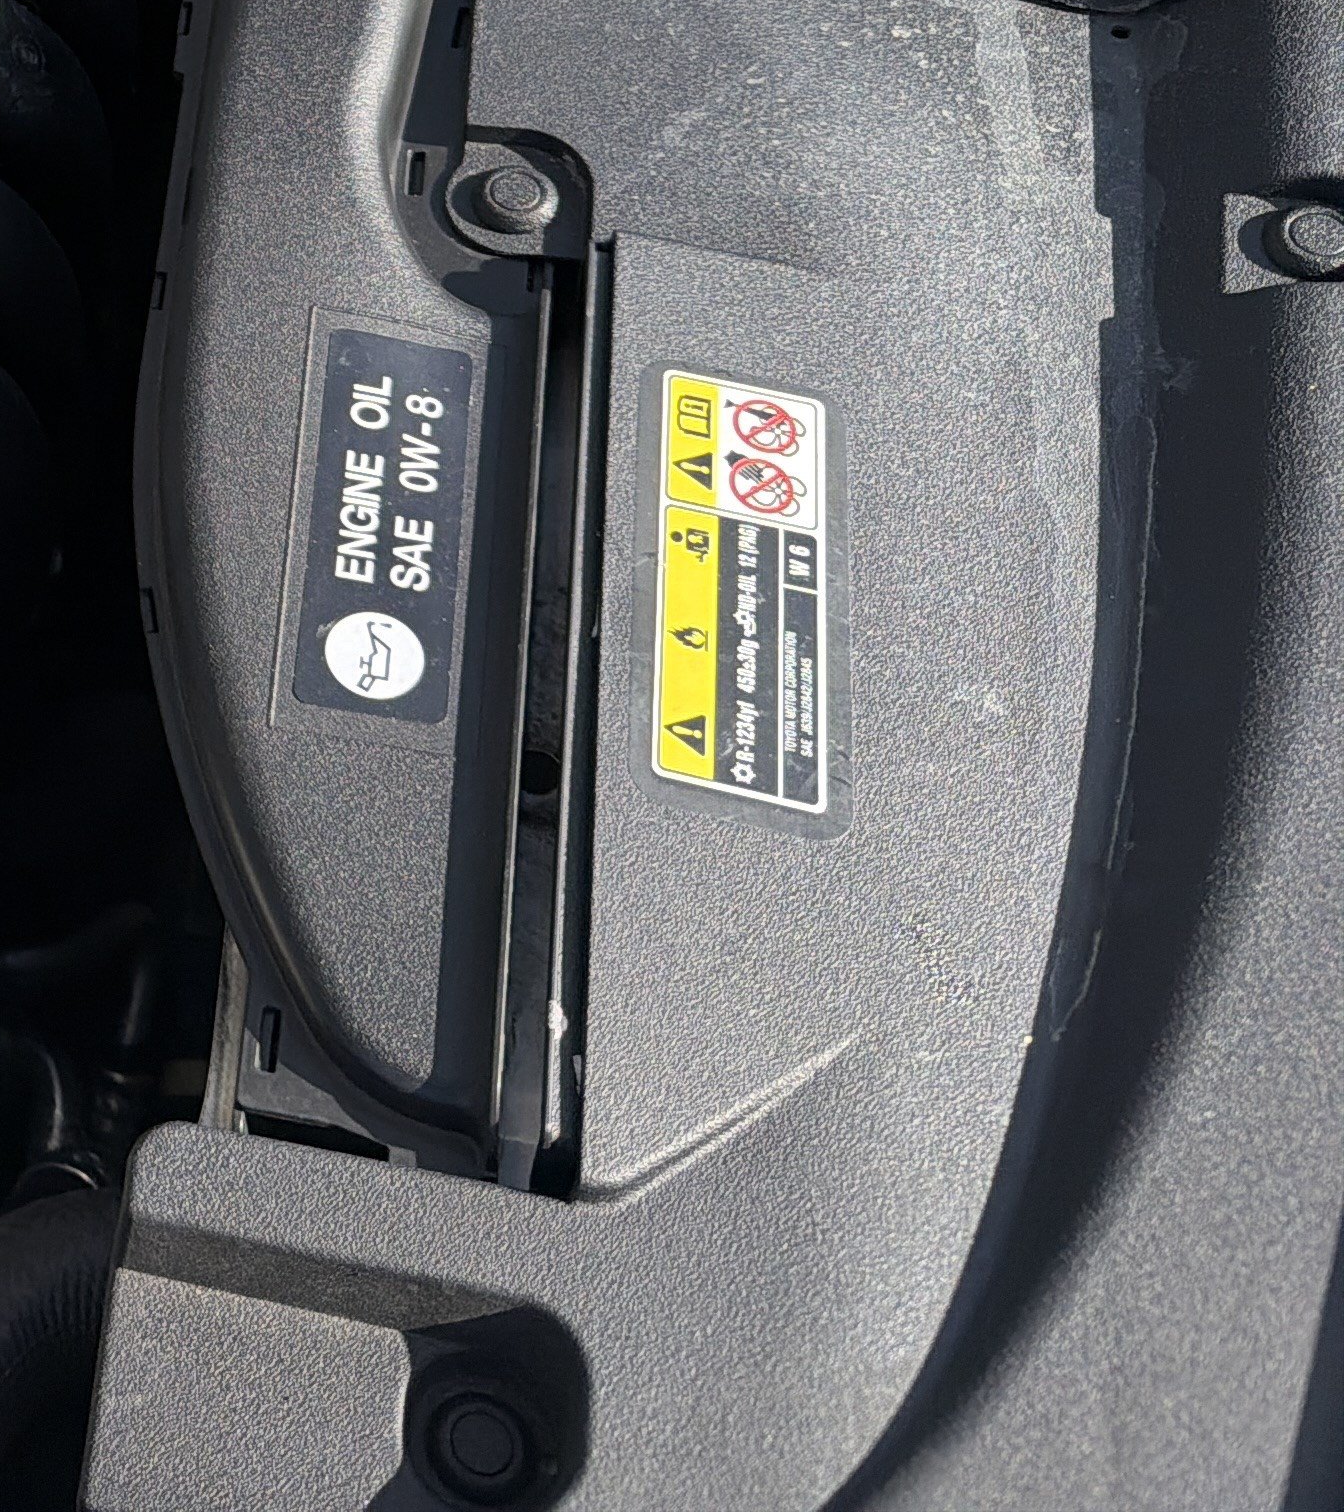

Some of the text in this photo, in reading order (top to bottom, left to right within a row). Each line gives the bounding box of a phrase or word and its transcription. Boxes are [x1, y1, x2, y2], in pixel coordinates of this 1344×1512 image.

[335, 376, 392, 584] ENGINE OIL
[389, 394, 444, 592] SAE 0W-8
[738, 524, 760, 554] (PAG)
[738, 554, 757, 568] 12
[738, 574, 757, 614] ND-OIL
[784, 631, 797, 752] TOYOTA MOTOR CORPORATION
[735, 700, 760, 763] R-1234yf
[800, 740, 813, 758] SAE
